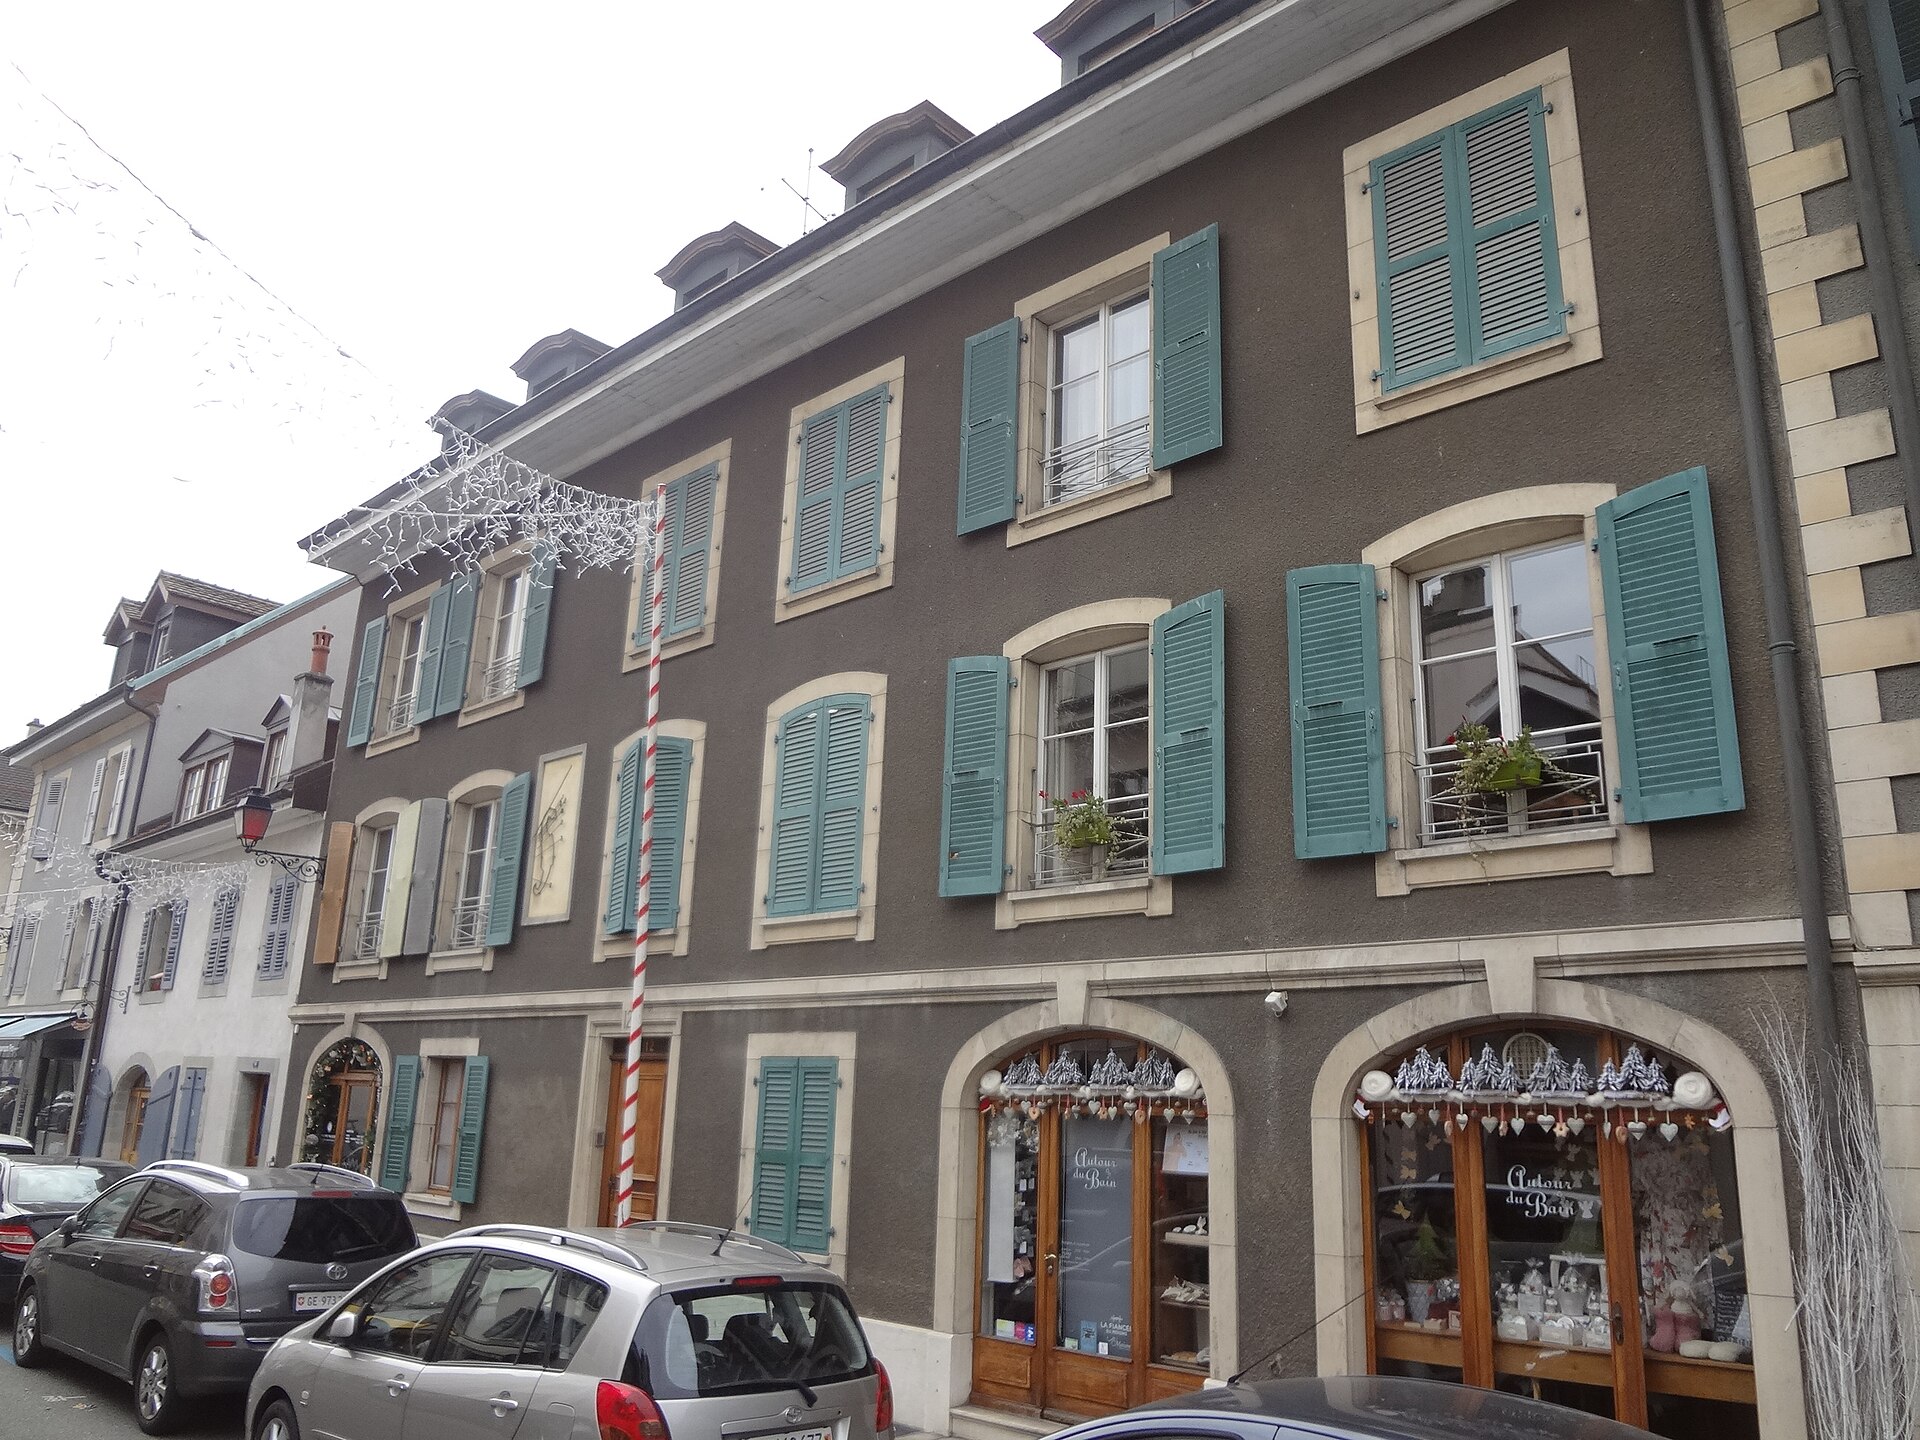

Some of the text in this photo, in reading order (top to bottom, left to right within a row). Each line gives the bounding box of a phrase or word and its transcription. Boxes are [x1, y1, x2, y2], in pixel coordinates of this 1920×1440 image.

[1075, 1146, 1118, 1168] Autour
[1073, 1167, 1117, 1190] du Bain
[1507, 1164, 1573, 1191] Autour
[1506, 1190, 1576, 1218] du Bain
[307, 1296, 318, 1307] GE
[1100, 1321, 1108, 1329] LA
